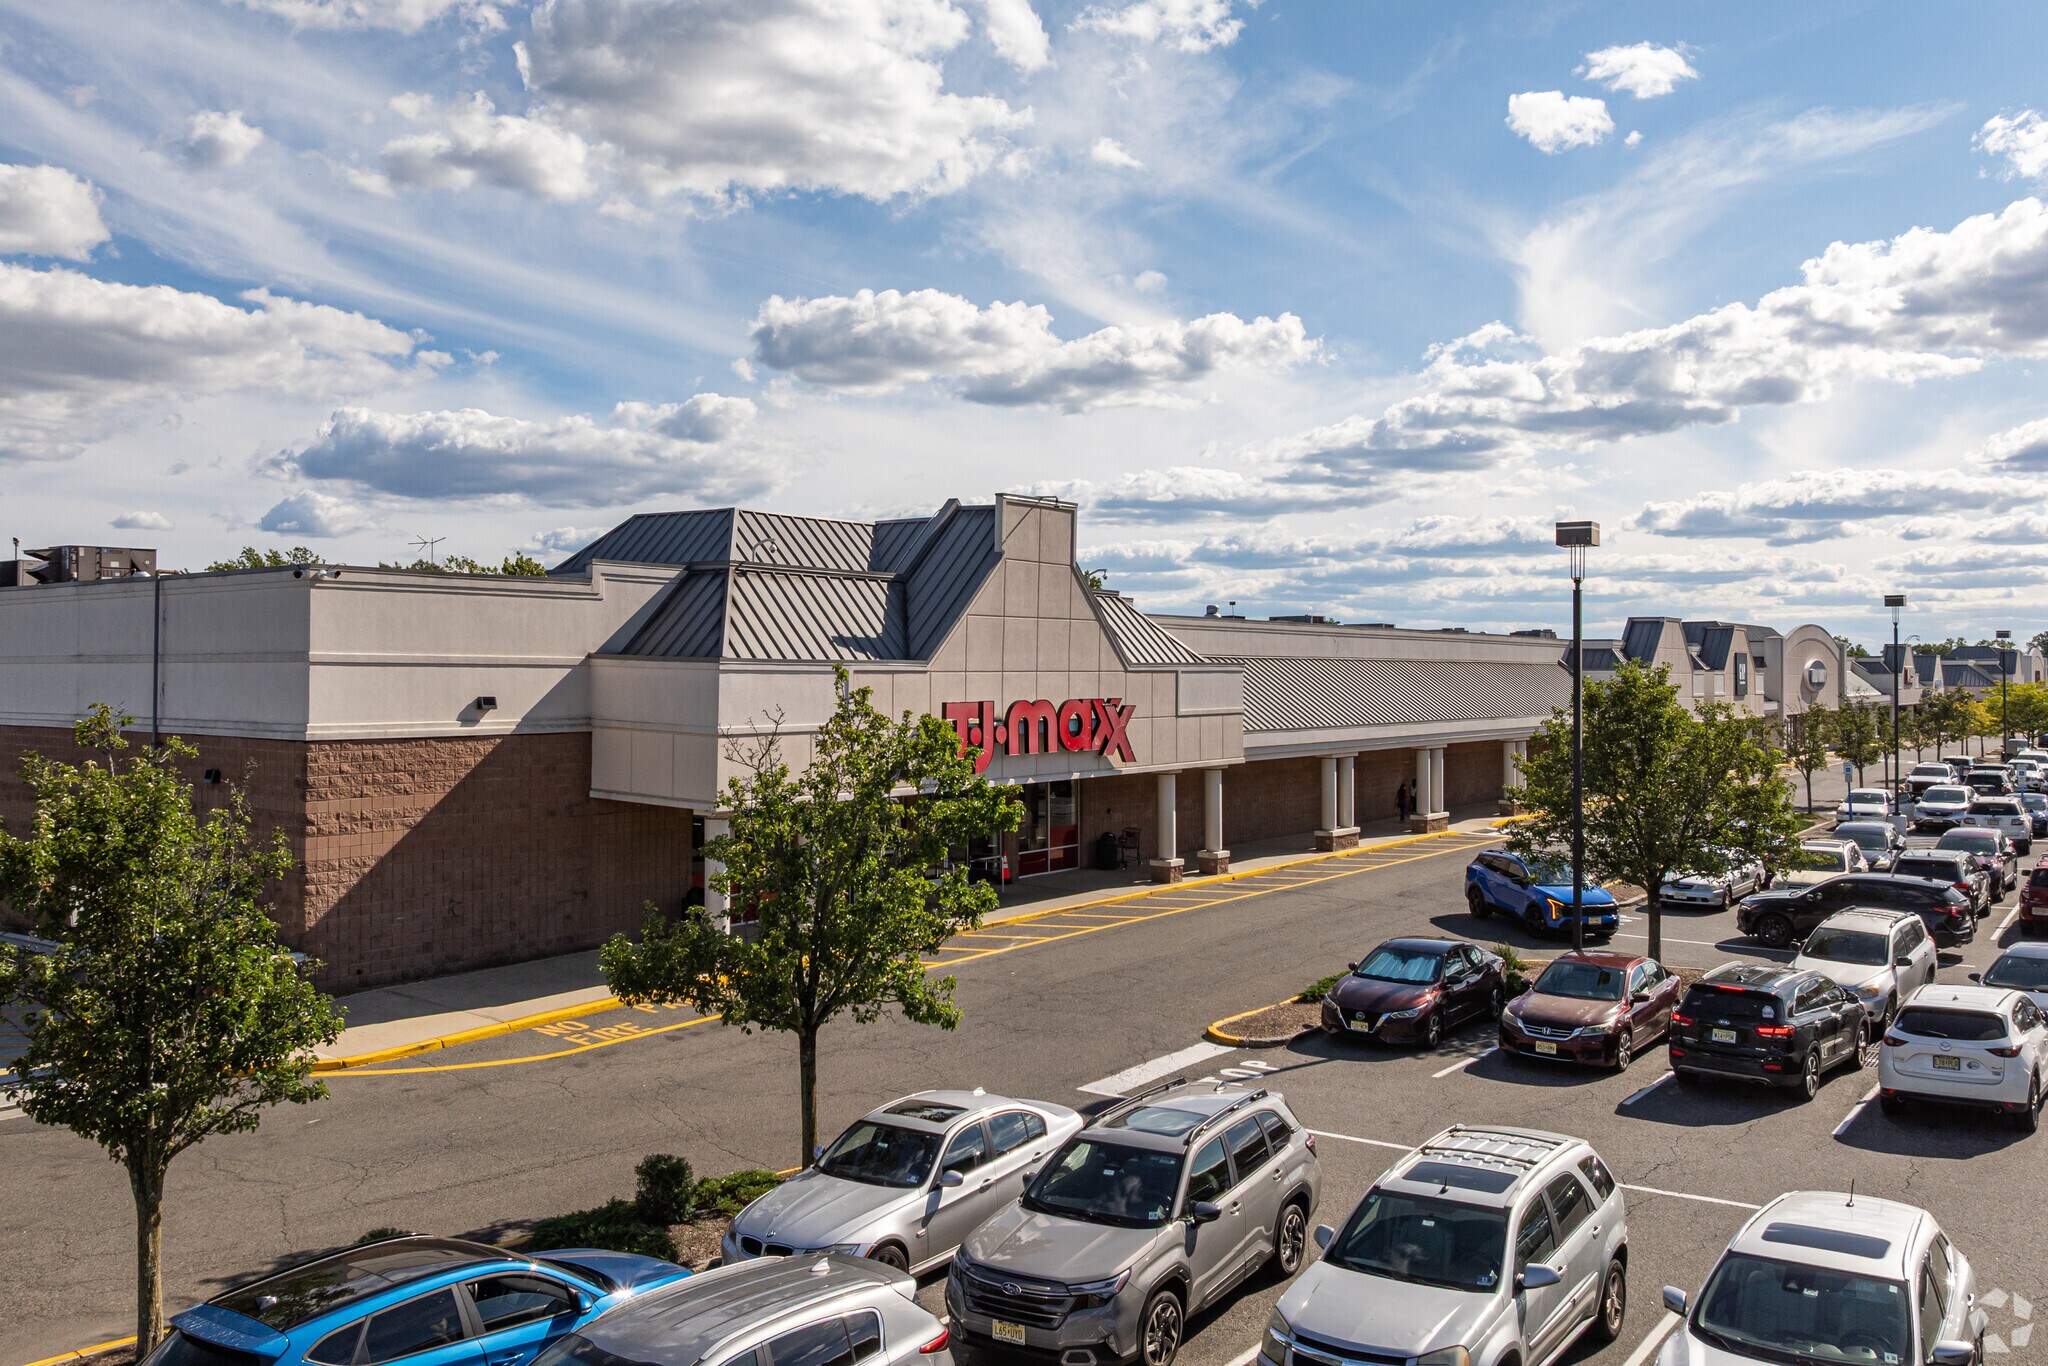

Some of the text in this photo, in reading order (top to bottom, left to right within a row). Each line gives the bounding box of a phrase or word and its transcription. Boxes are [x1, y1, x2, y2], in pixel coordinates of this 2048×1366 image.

[532, 1020, 590, 1037] NO
[563, 1022, 653, 1046] FIRE
[1196, 1060, 1280, 1086] TOP
